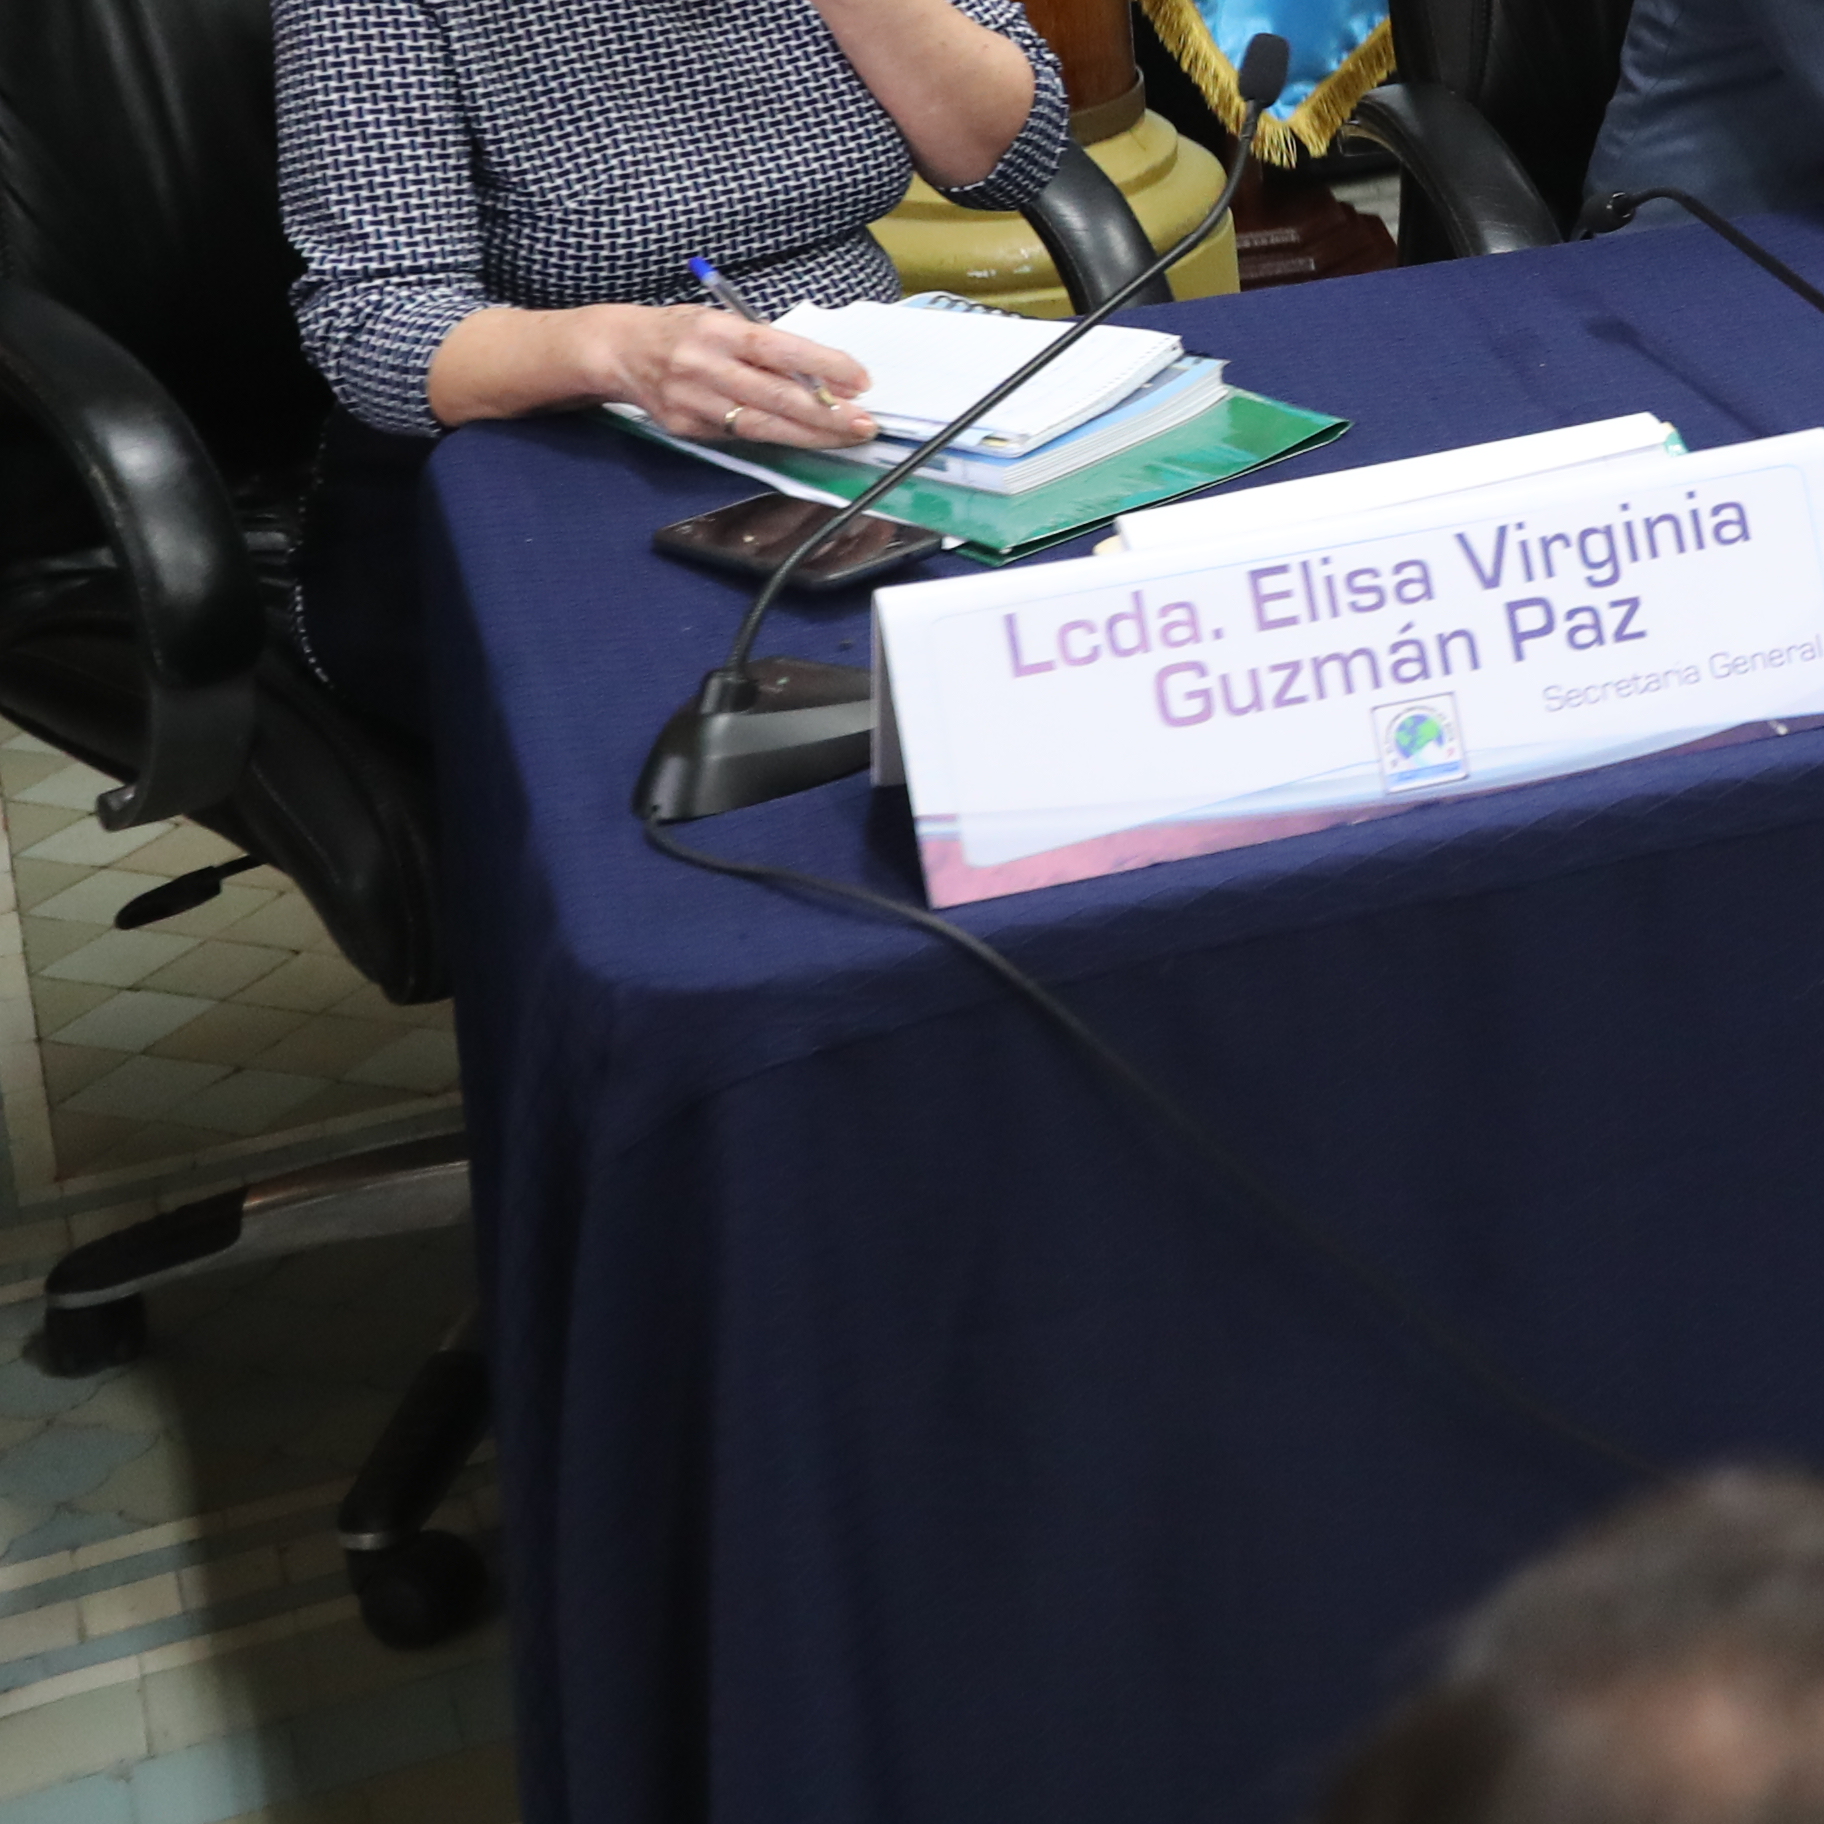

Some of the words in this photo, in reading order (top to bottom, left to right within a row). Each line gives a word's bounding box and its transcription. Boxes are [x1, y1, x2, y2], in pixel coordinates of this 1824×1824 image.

[1001, 588, 1226, 680] Lcda.
[1245, 555, 1436, 634] Elisa
[1452, 489, 1753, 591] Virginia
[1153, 620, 1483, 728] Guzmán
[1502, 595, 1649, 664] Paz
[1541, 659, 1702, 714] Secretaria
[1707, 633, 1824, 680] General
